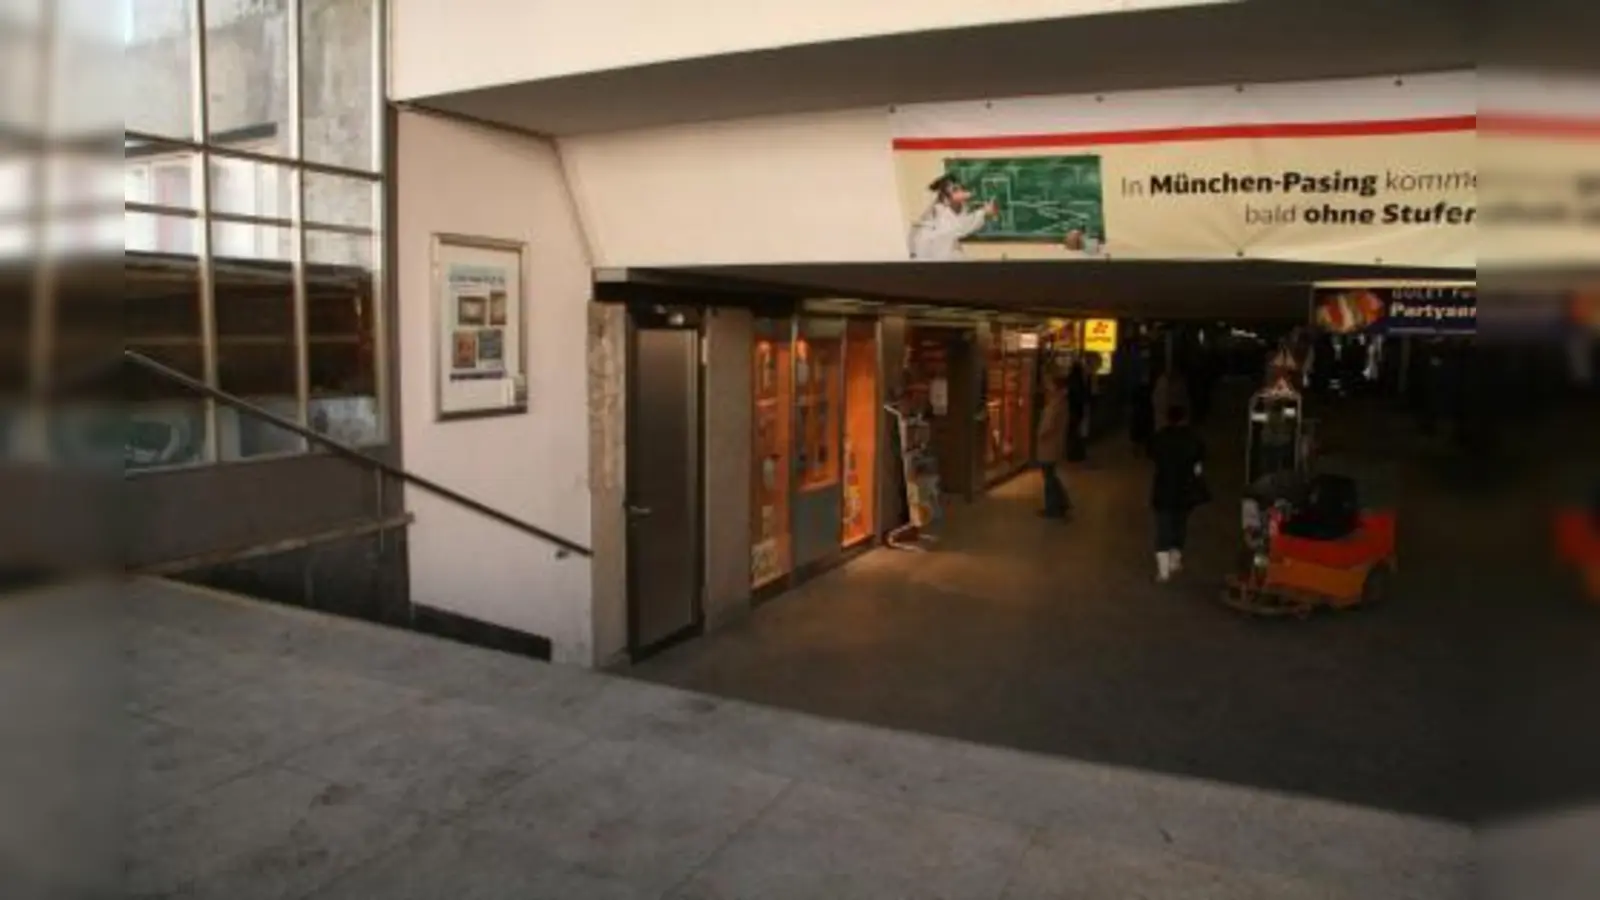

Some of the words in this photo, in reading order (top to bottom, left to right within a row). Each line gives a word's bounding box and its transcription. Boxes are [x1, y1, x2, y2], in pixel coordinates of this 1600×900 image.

[1120, 177, 1144, 197] In
[1150, 171, 1379, 196] München-Pasing
[1244, 204, 1297, 224] bald
[1303, 204, 1376, 224] ohne
